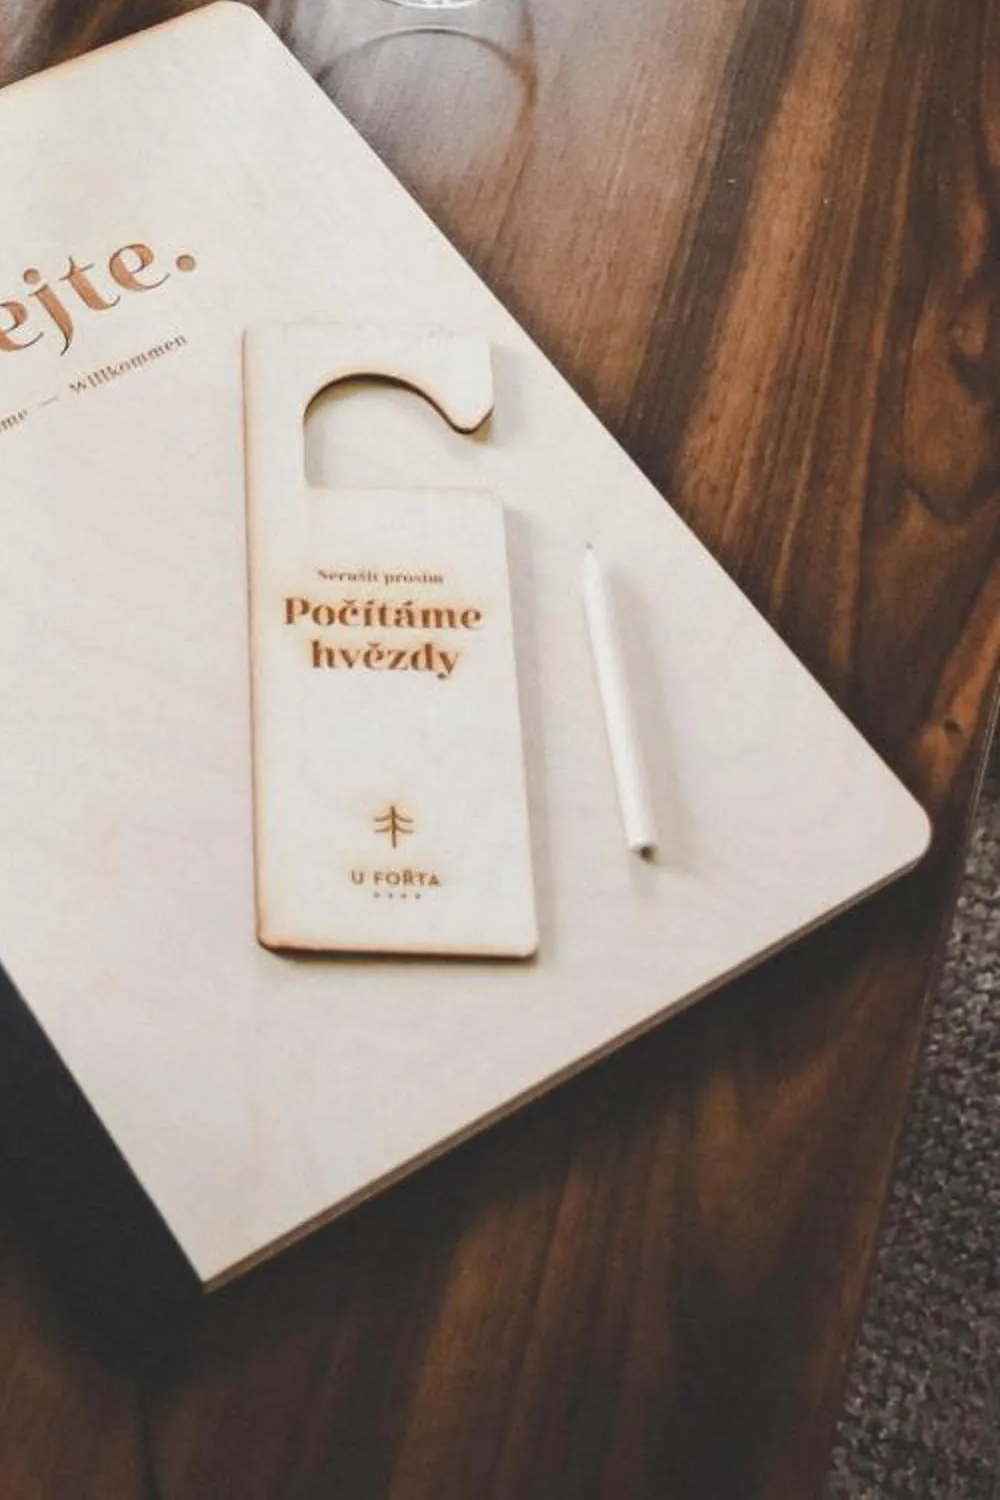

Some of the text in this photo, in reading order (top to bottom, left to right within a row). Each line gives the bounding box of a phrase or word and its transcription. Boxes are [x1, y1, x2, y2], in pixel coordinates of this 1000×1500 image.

[283, 596, 484, 630] Počítáme
[310, 638, 460, 680] hvězdy
[351, 869, 364, 885] U
